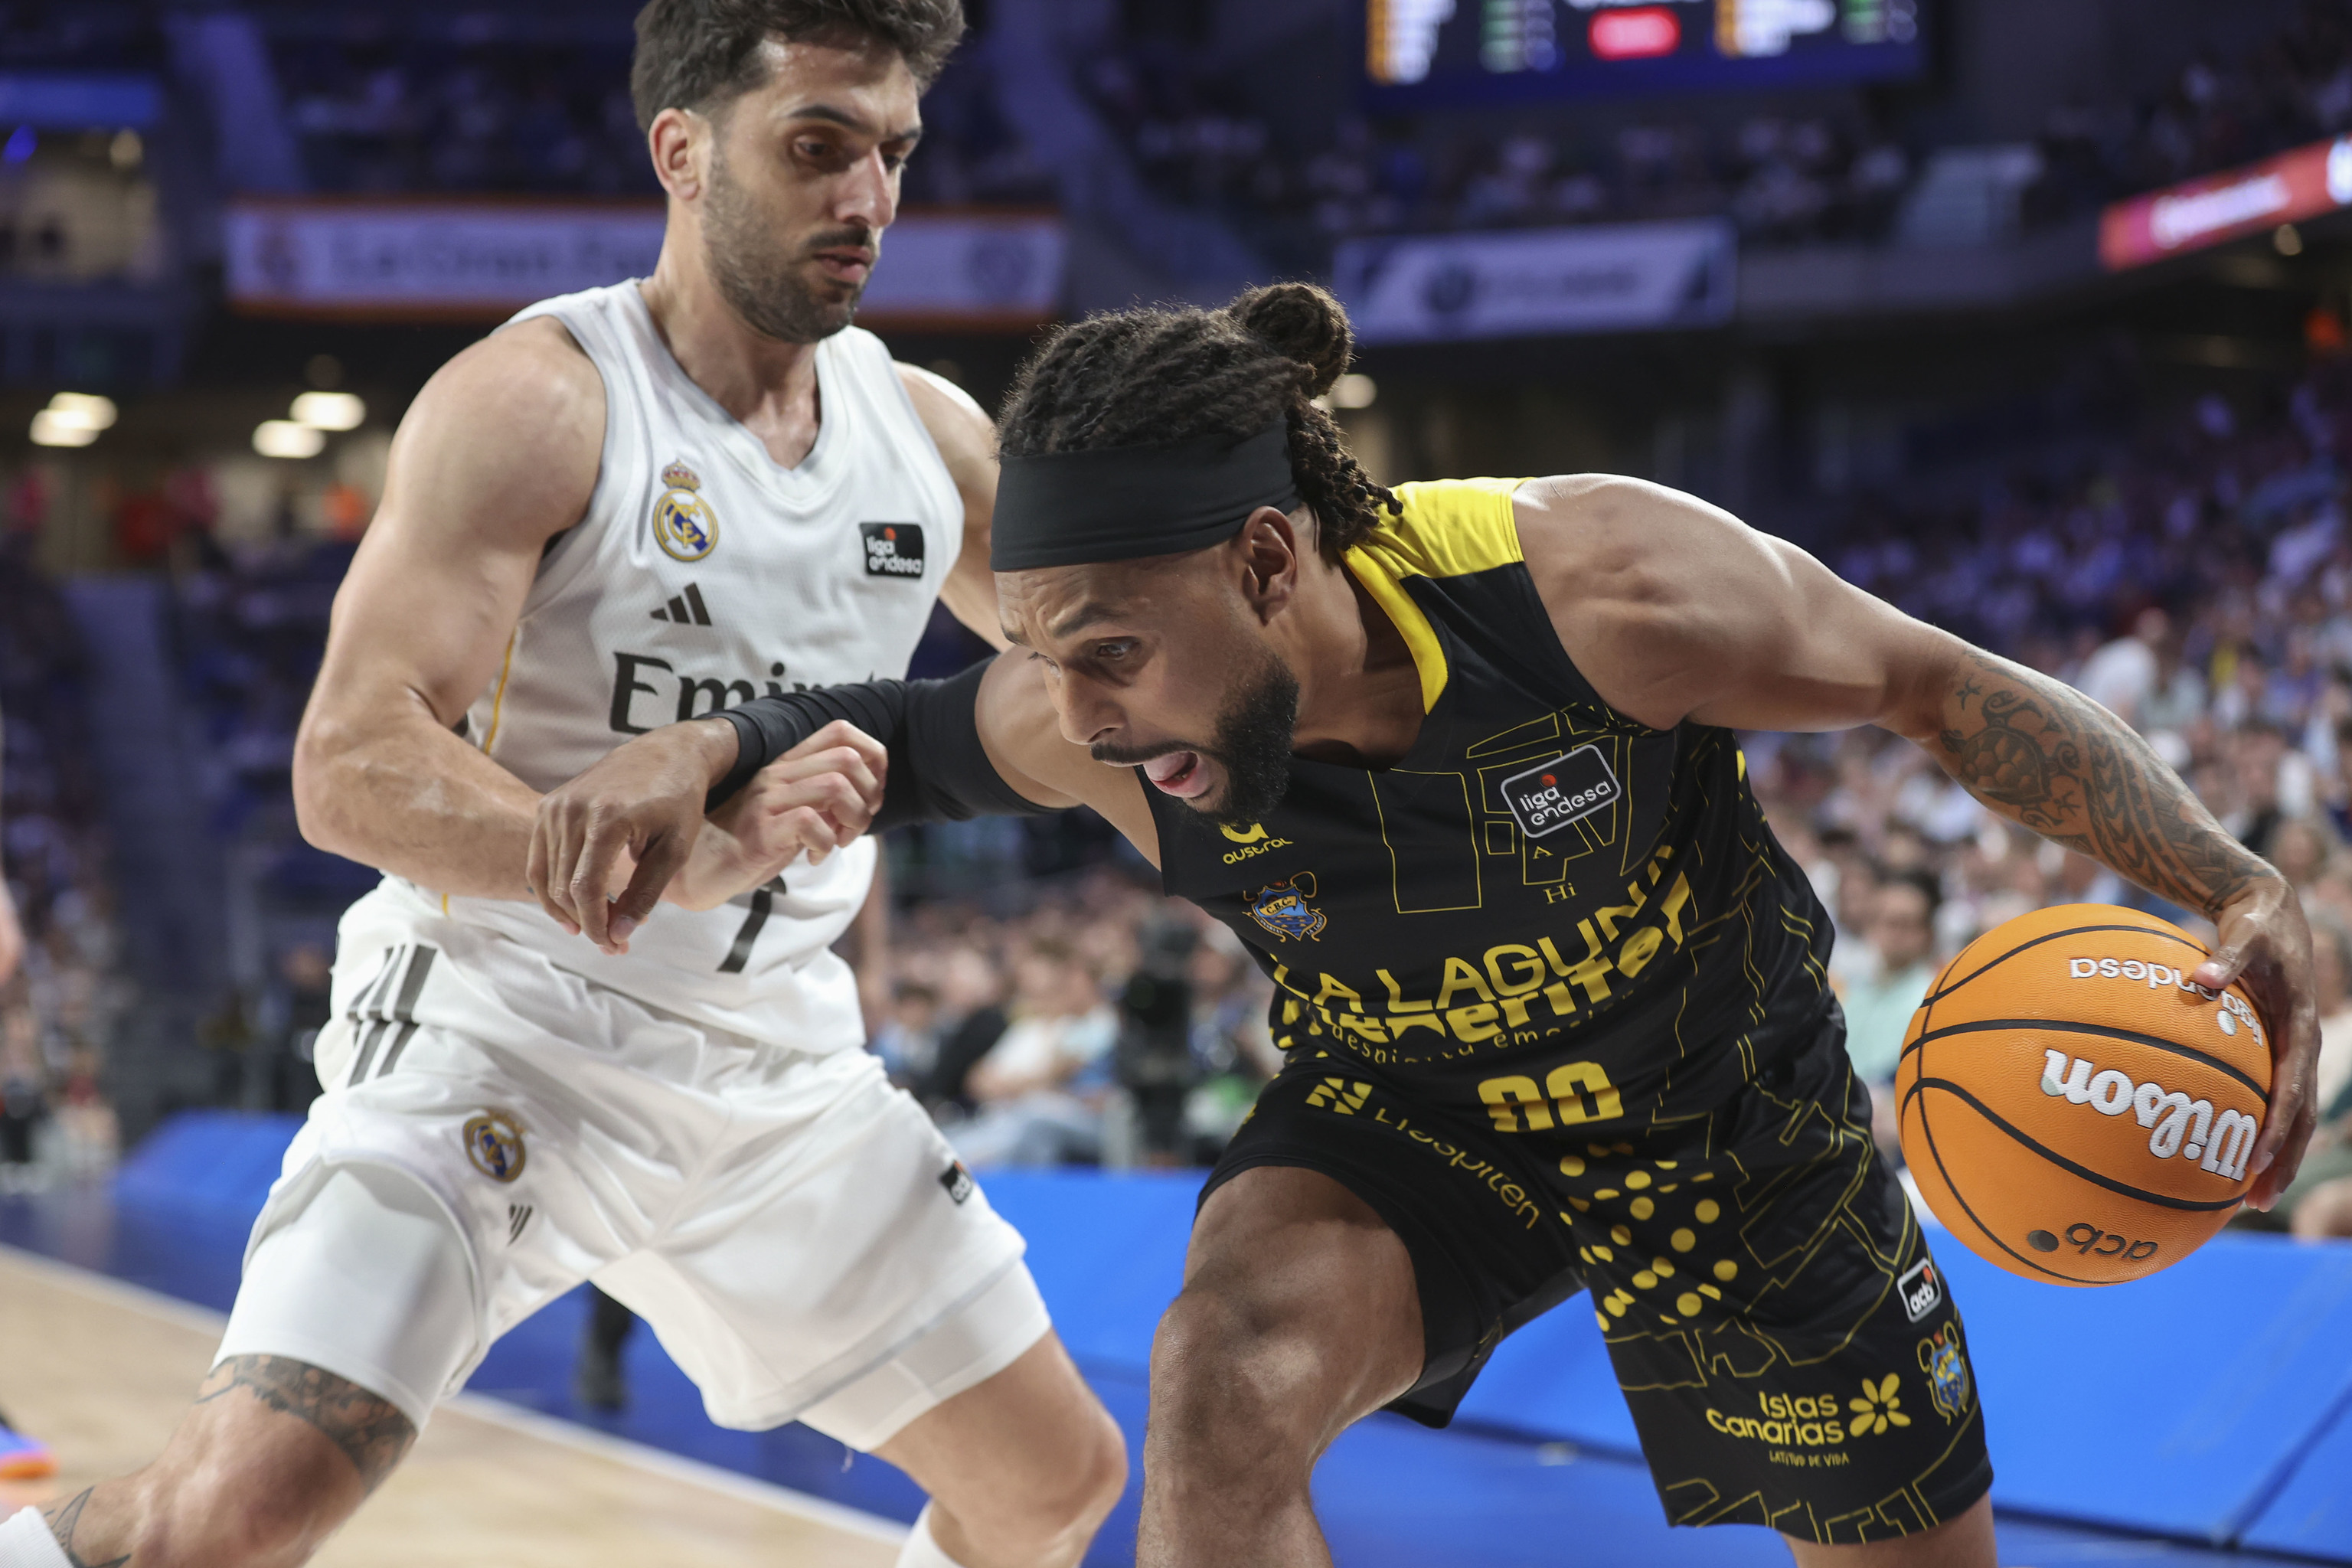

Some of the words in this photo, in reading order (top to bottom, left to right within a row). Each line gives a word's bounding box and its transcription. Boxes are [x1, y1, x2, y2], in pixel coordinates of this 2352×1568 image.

[866, 535, 895, 557] liga
[868, 554, 922, 574] endesa
[1518, 786, 1561, 812] liga
[1530, 780, 1612, 826] endesa
[1223, 838, 1294, 864] austral
[1542, 882, 1577, 905] Hi
[2040, 1047, 2257, 1182] Wilson
[2066, 1223, 2159, 1260] acb
[1909, 1282, 1935, 1313] acb
[1758, 1390, 1839, 1419] Islas
[1706, 1408, 1845, 1446] Canarias
